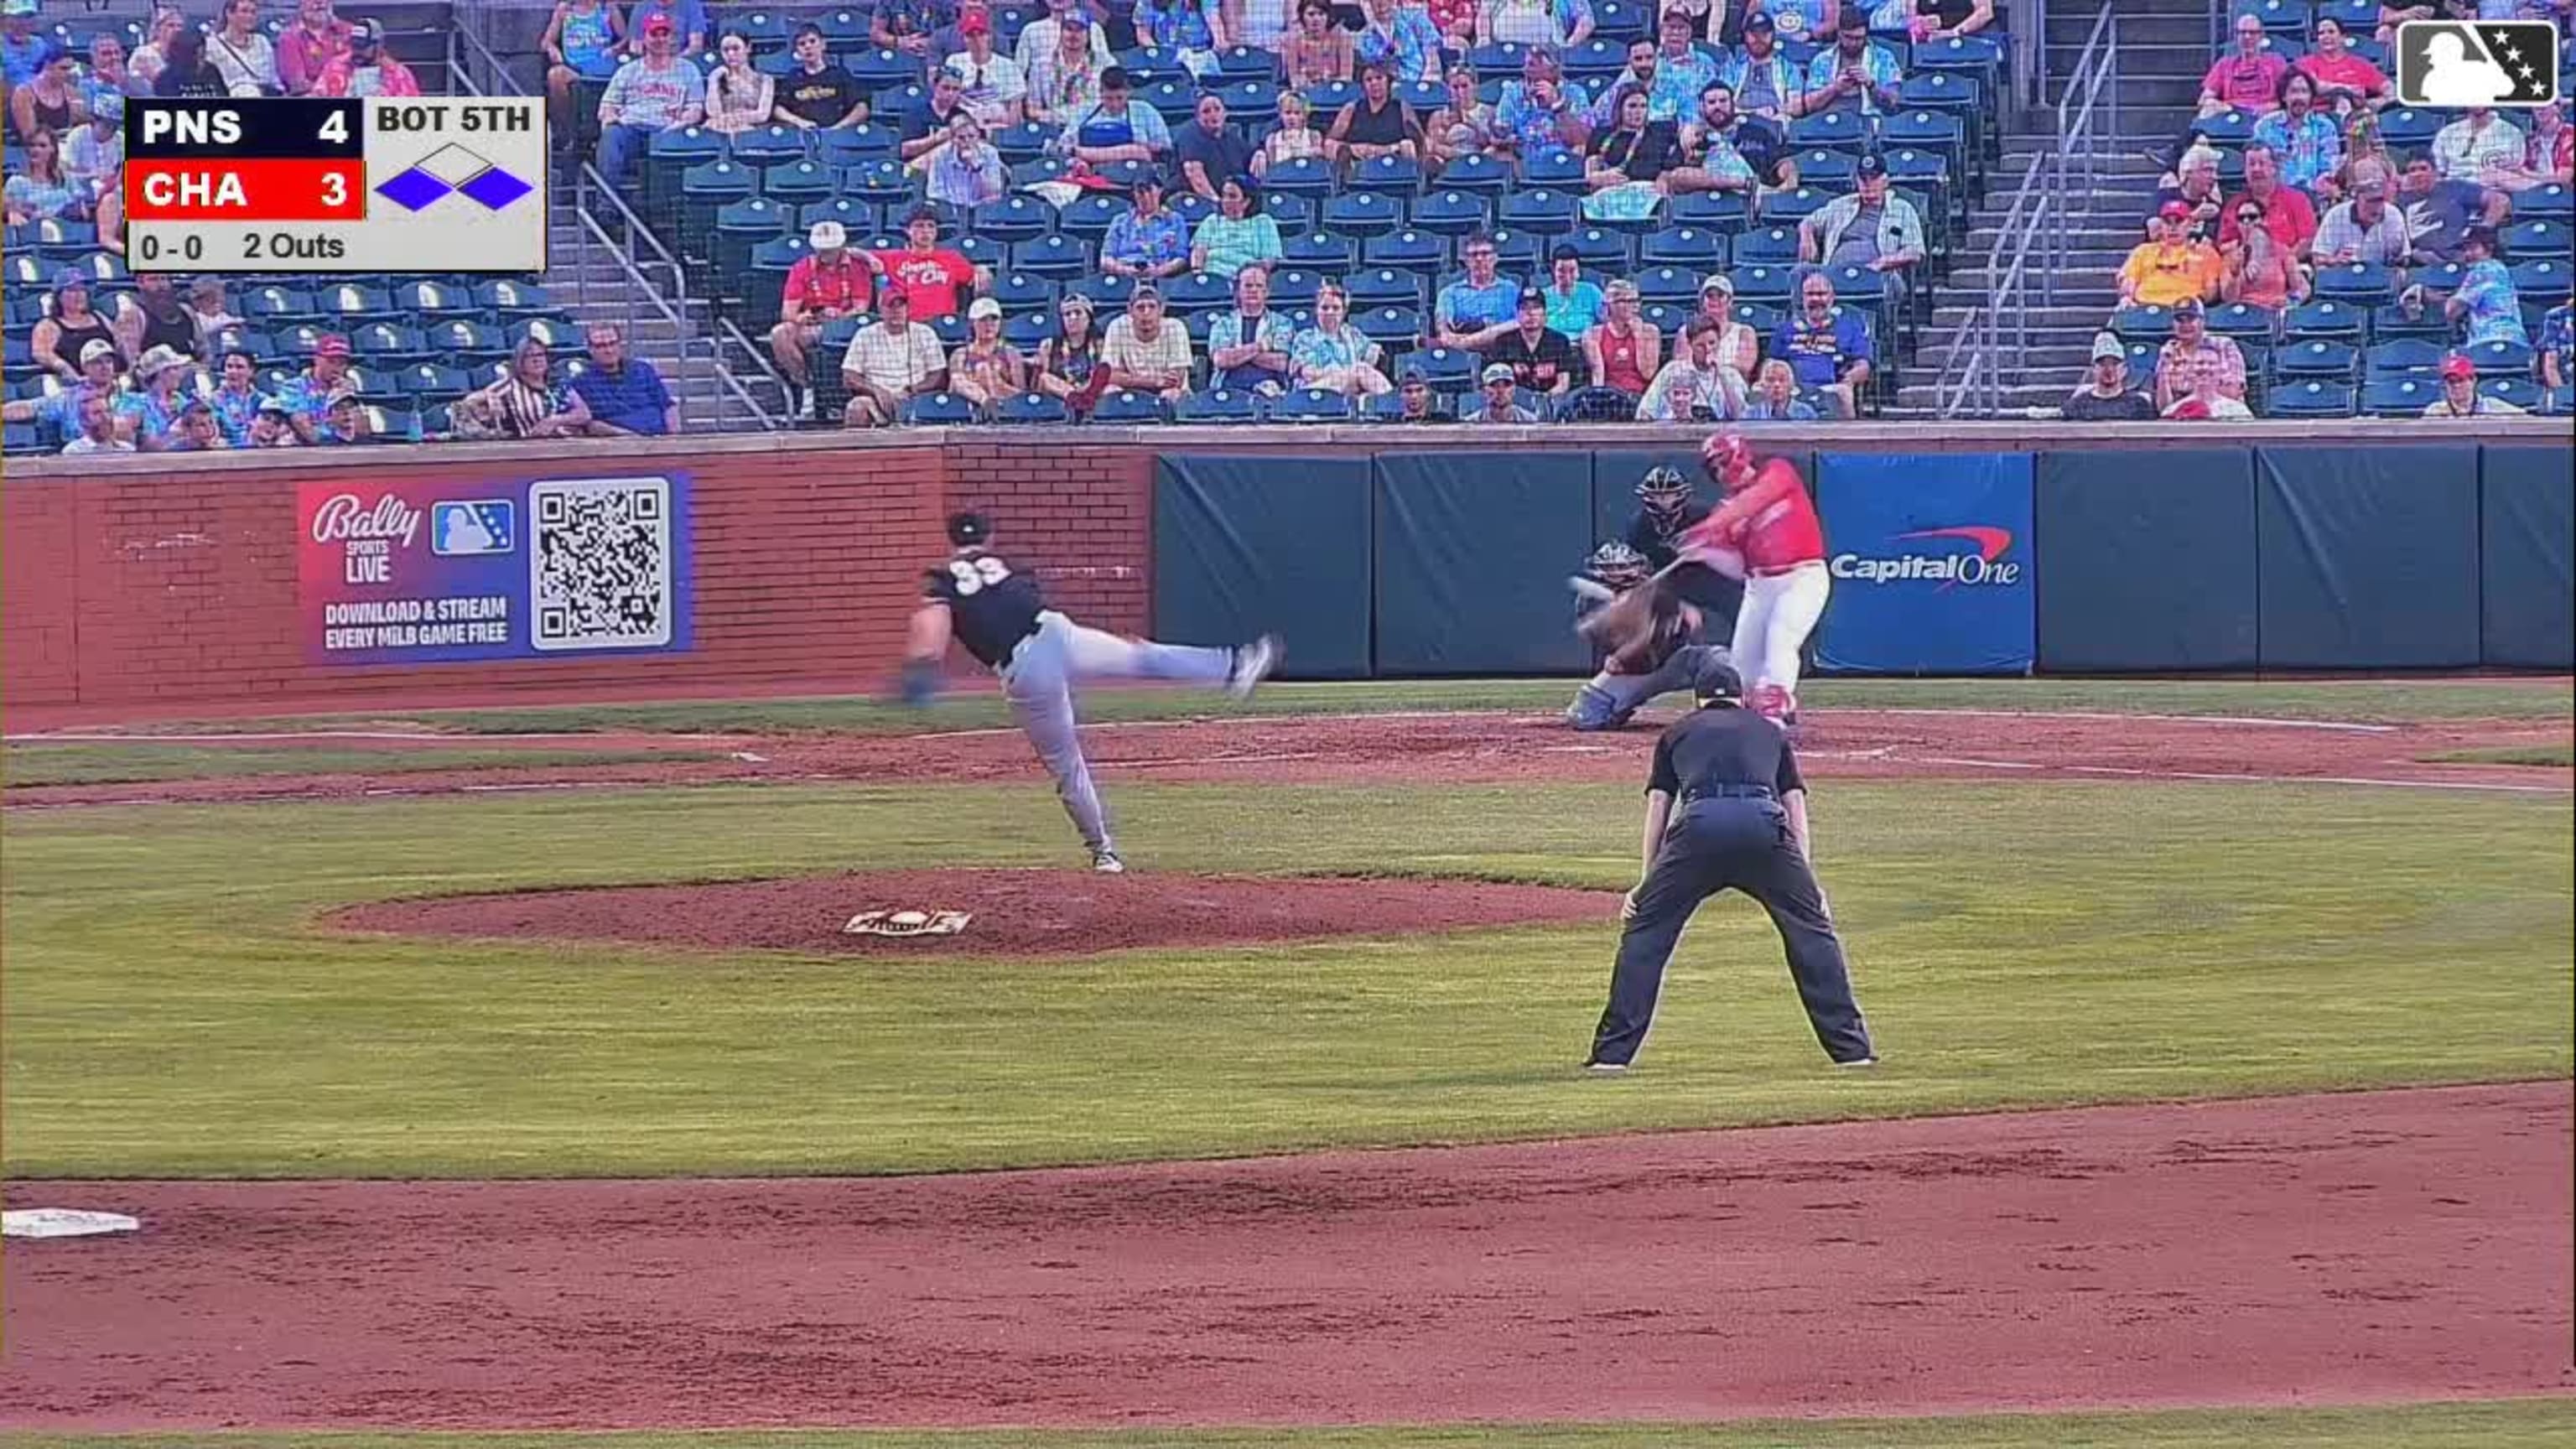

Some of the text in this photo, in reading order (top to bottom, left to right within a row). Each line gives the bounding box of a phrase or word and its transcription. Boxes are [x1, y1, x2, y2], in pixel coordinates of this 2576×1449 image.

[313, 495, 421, 548] Bally
[345, 539, 389, 556] SPORTS
[345, 556, 391, 583] LIVE
[325, 596, 506, 625] DOWNLOAD & STREAM
[325, 628, 375, 649] EVERY
[418, 624, 466, 645] GAME
[468, 622, 507, 642] FREE
